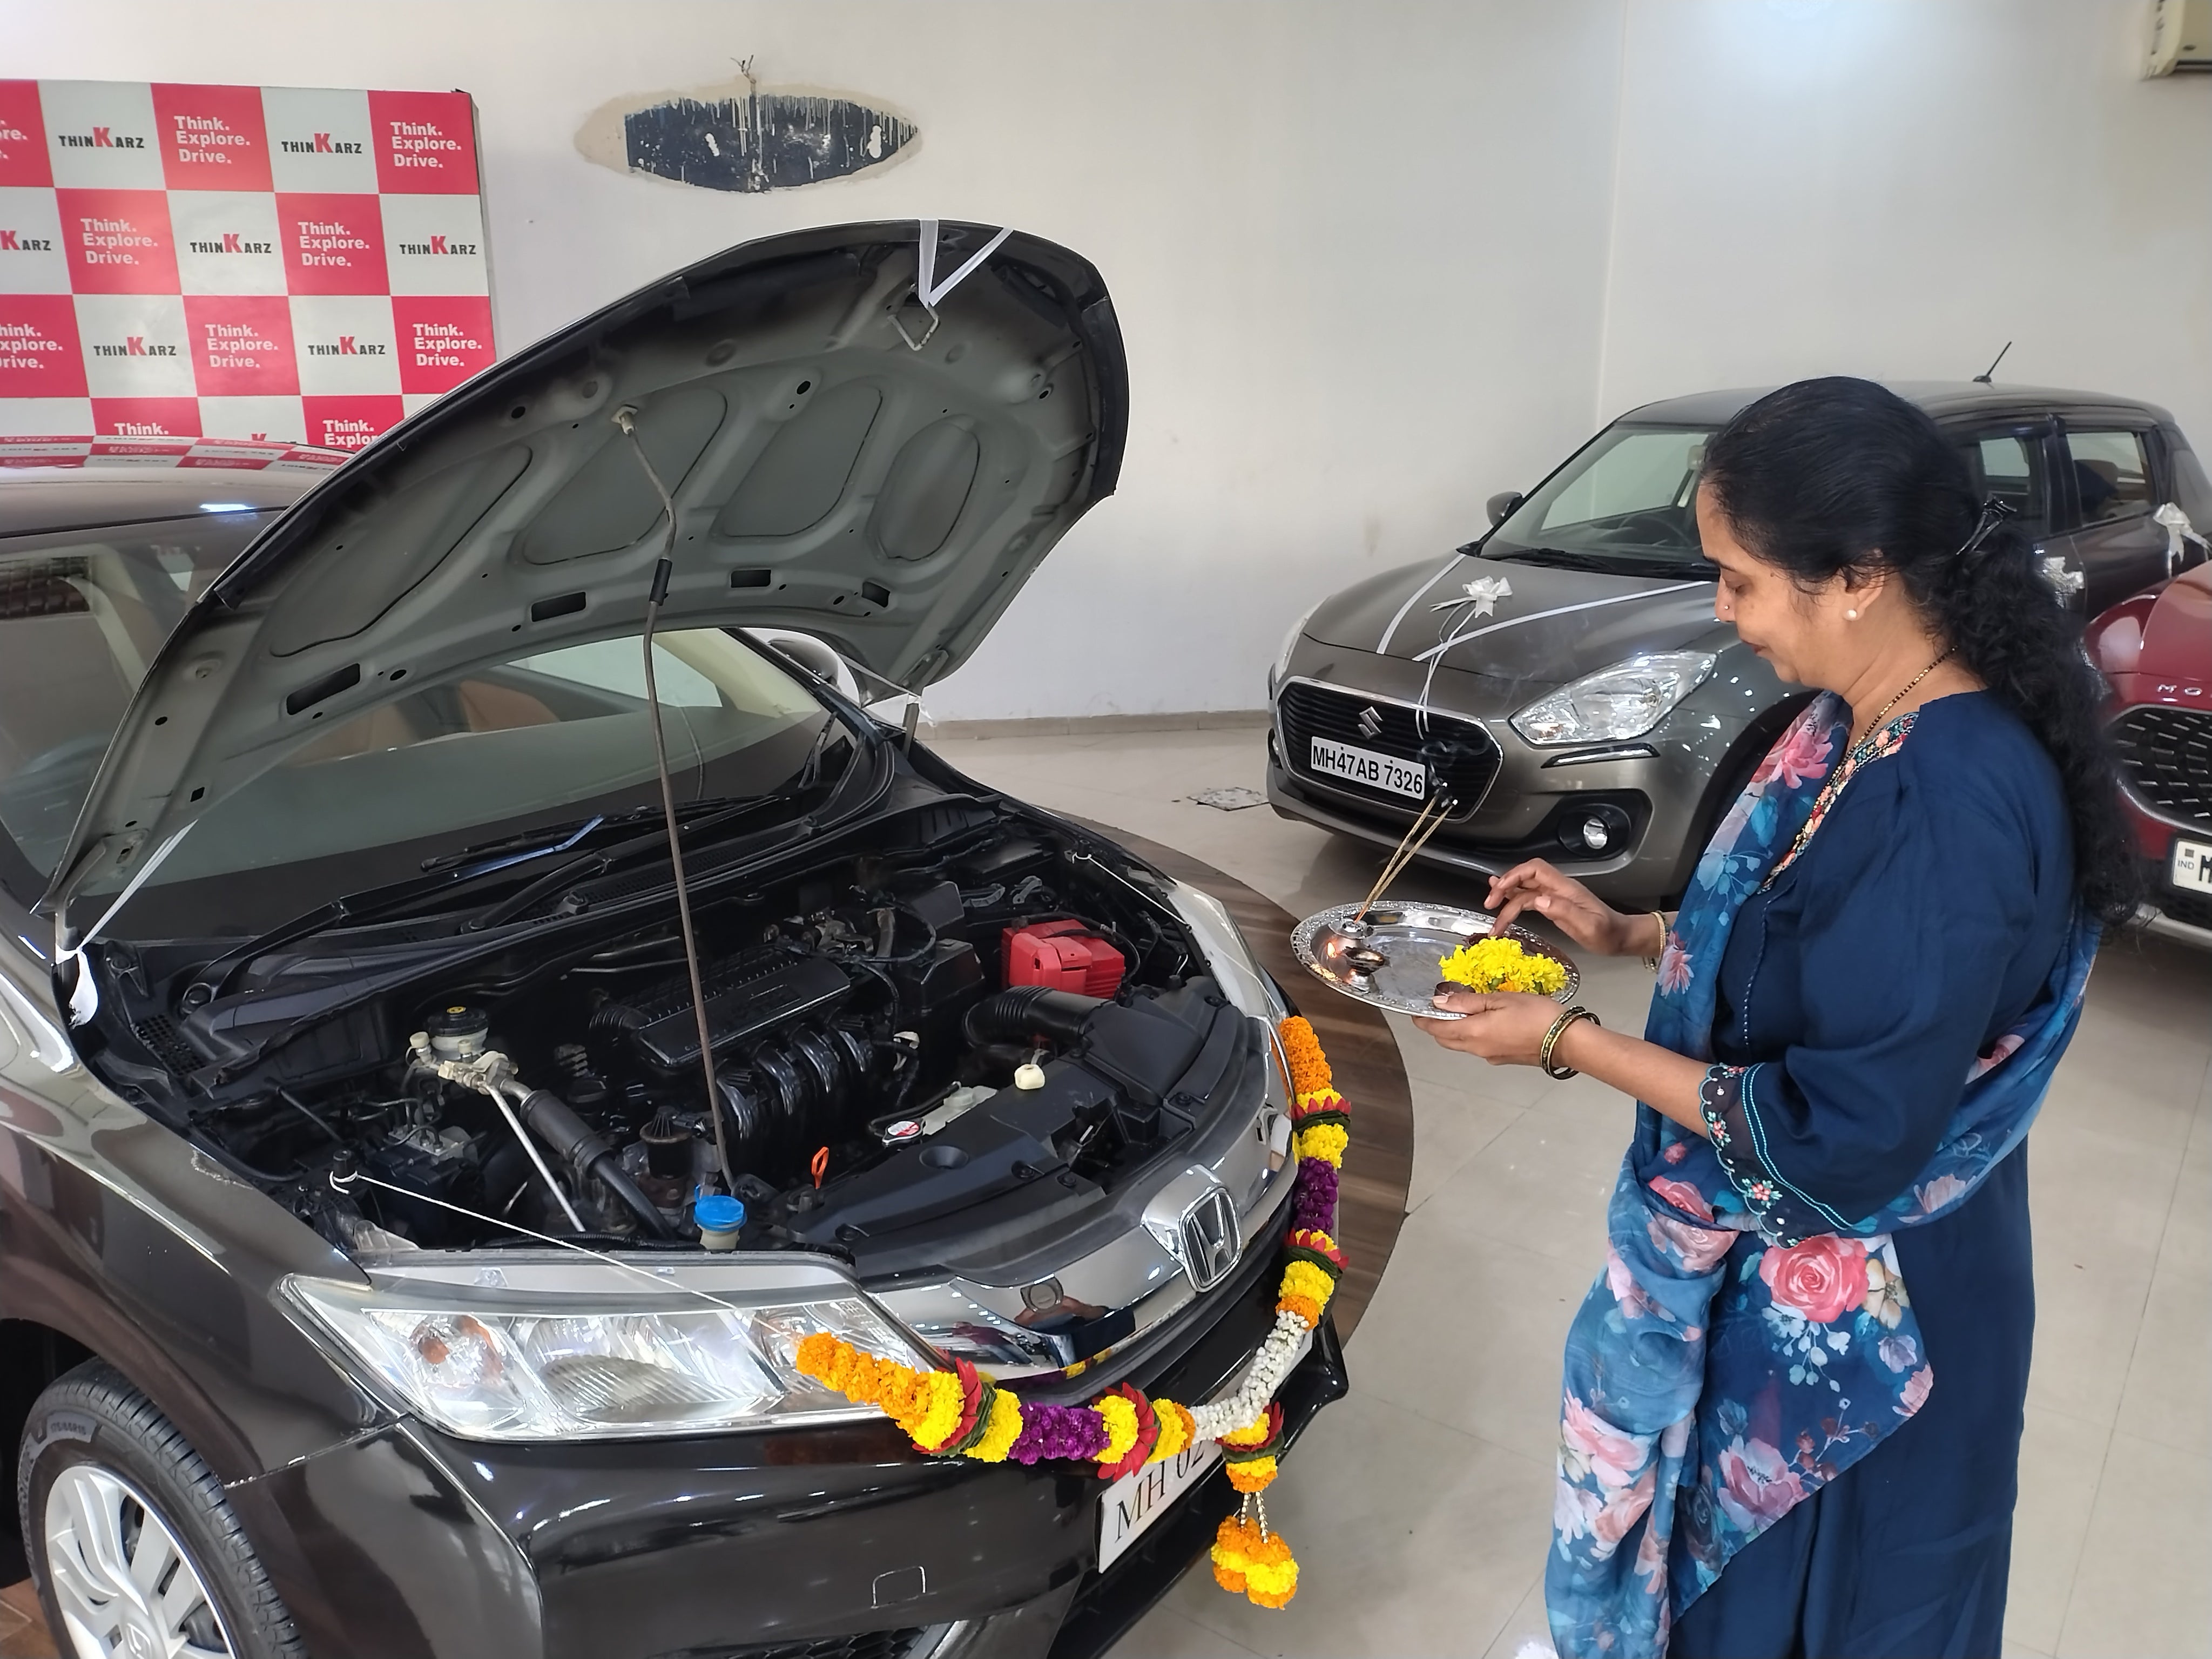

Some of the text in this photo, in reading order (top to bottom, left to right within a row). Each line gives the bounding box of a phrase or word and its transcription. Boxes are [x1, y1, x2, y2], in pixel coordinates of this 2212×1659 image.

[174, 116, 230, 130] Think.
[390, 122, 442, 136] Think.
[59, 127, 144, 148] THINKARZ
[176, 131, 250, 147] Explore.
[281, 133, 362, 154] THINKARZ
[392, 137, 461, 152] Explore.
[179, 149, 232, 164] Drive.
[394, 154, 443, 167] Drive.
[80, 218, 137, 232] Think.
[298, 221, 350, 235] Think.
[0, 230, 51, 251] KARZ
[83, 233, 158, 248] Explore.
[190, 234, 271, 253] THINKARZ
[300, 236, 369, 251] Explore.
[399, 236, 476, 255] THINKARZ
[86, 251, 139, 264] Drive.
[301, 253, 351, 266] Drive.
[0, 323, 41, 336] hink.
[205, 324, 258, 337] Think.
[413, 323, 463, 336] Think.
[0, 338, 63, 353] xplore.
[93, 337, 176, 356] THINKARZ
[207, 338, 278, 353] Explore.
[308, 336, 385, 355] THINKARZ
[414, 338, 482, 352] Explore.
[0, 355, 44, 368] rive.
[209, 355, 260, 368] Drive.
[416, 353, 464, 366] Drive.
[114, 422, 169, 435] Think.
[322, 420, 374, 432] Think.
[324, 433, 379, 448] Explor
[1313, 746, 1422, 794] MH47AB 7326
[2178, 860, 2194, 870] IND
[1115, 1460, 1165, 1543] MH
